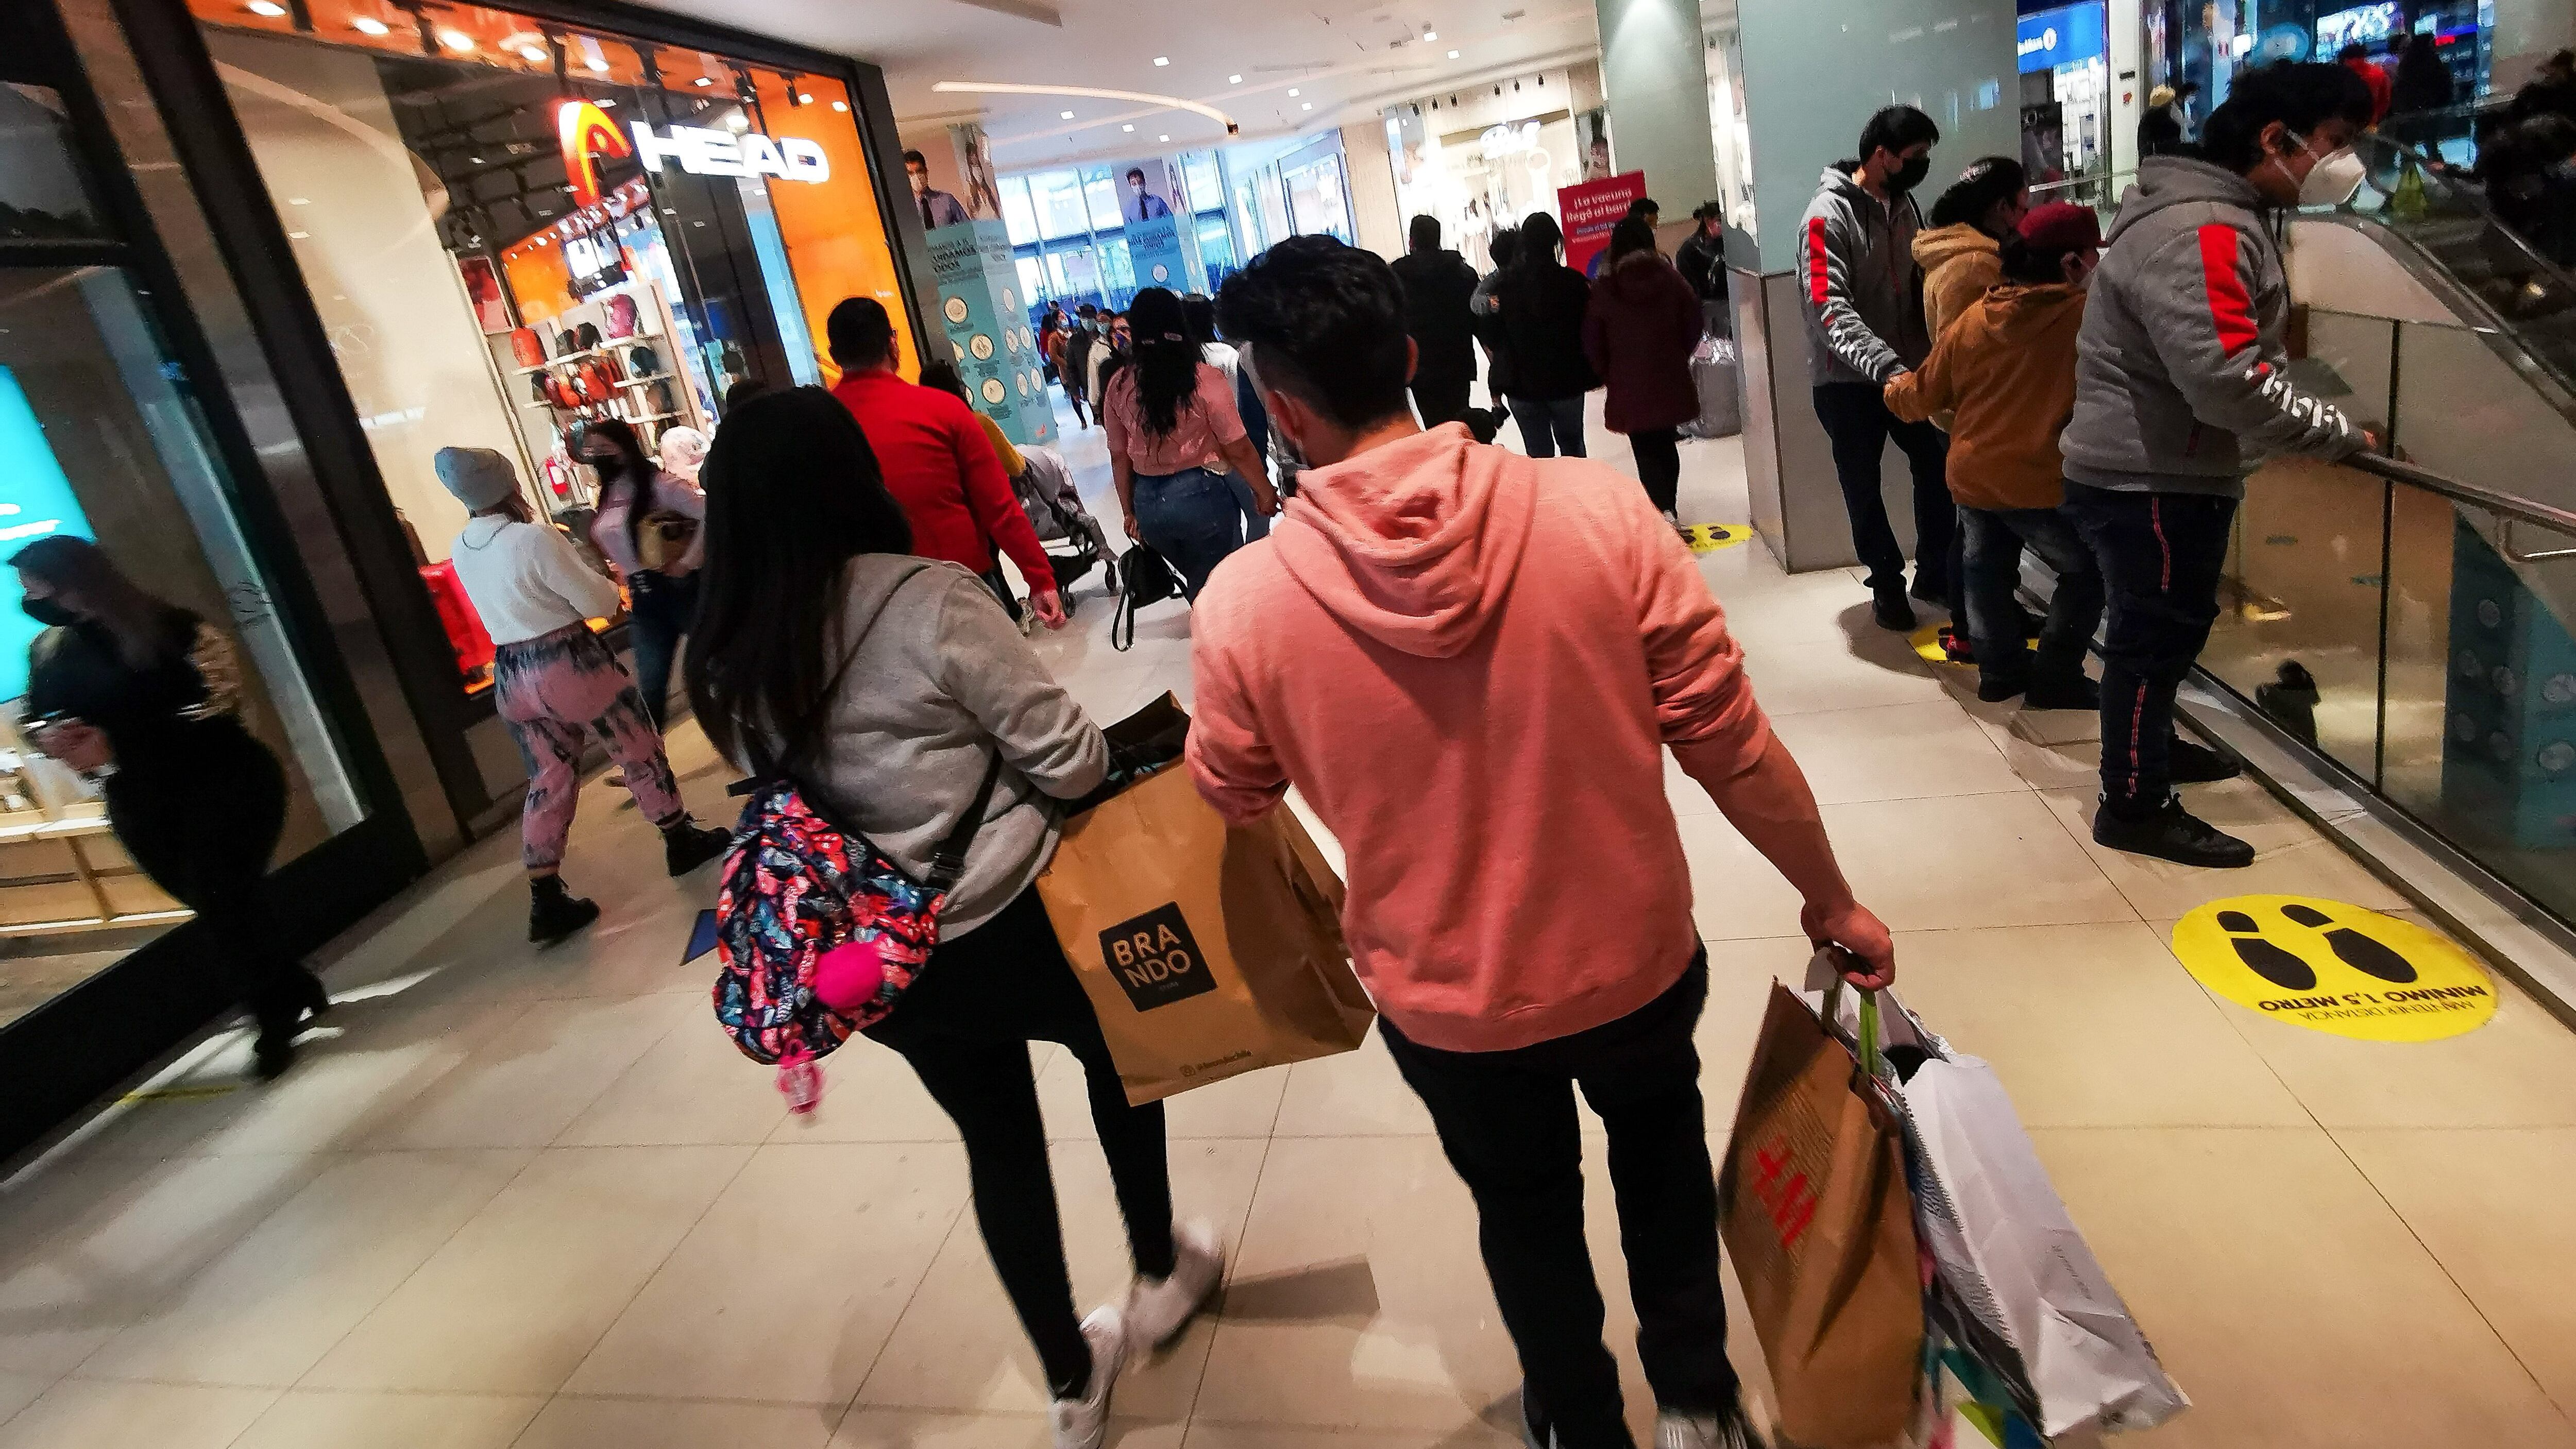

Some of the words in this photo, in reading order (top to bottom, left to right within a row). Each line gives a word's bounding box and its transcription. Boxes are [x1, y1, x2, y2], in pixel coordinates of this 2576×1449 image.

[629, 120, 831, 182] HEAD
[1112, 923, 1181, 967] BRA
[1125, 949, 1192, 988] NDO
[2342, 992, 2381, 1005] 1,5
[2383, 985, 2489, 1003] MINIMO
[2258, 995, 2341, 1012] METRO
[2297, 1007, 2384, 1022] DISTANCIA
